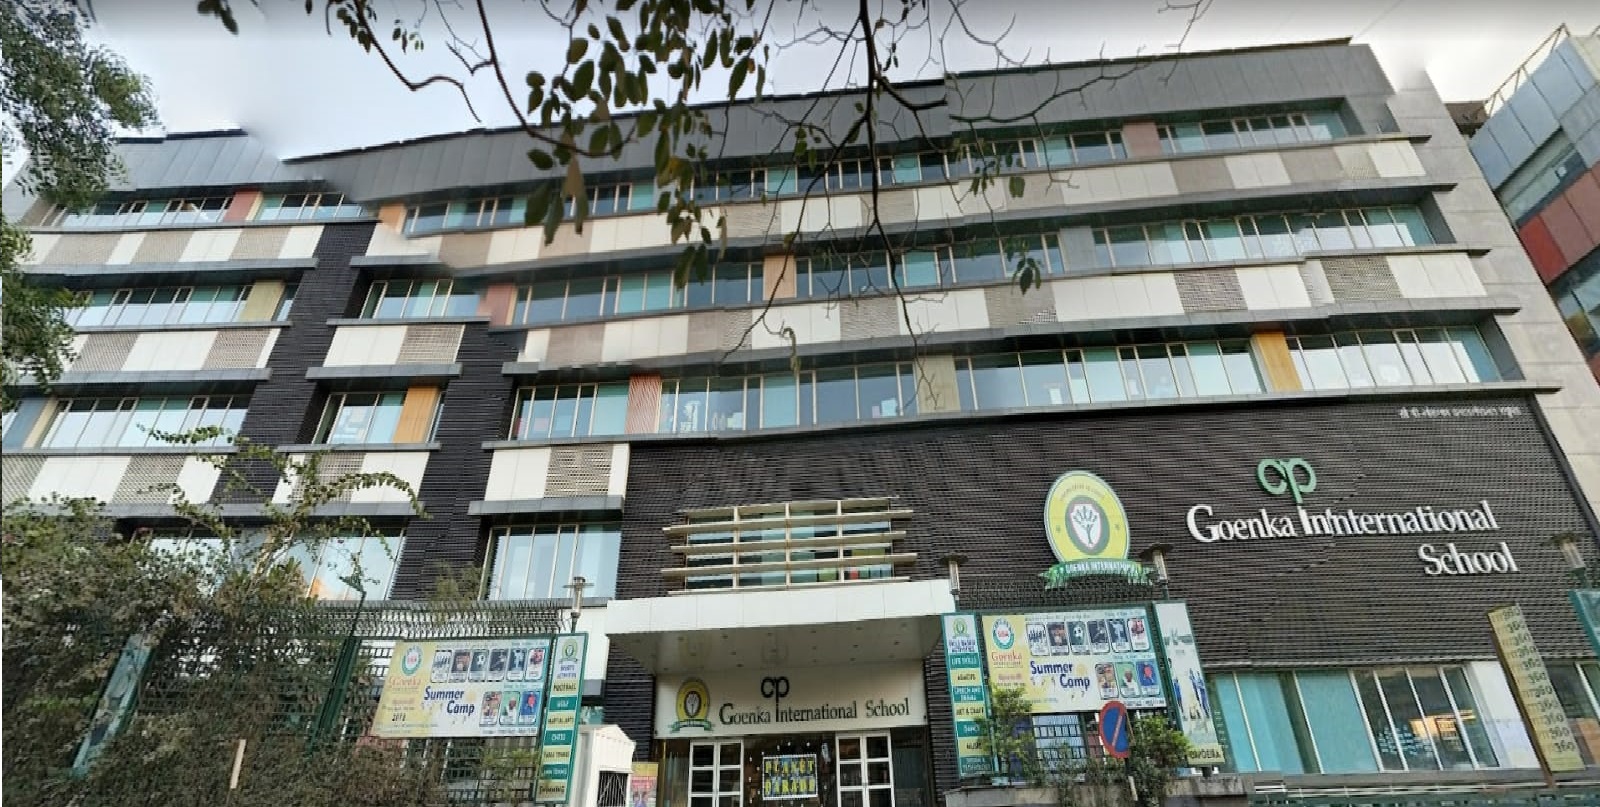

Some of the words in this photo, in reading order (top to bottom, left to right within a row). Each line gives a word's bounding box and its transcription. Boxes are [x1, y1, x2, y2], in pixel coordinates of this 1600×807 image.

[1186, 503, 1297, 542] Goenka
[1417, 541, 1520, 575] School
[1030, 660, 1073, 675] Summer
[1059, 673, 1090, 691] Camp
[424, 685, 465, 700] Summer
[446, 700, 475, 716] Camp
[719, 703, 771, 725] Goenka
[775, 700, 857, 722] International
[865, 697, 910, 717] School
[765, 759, 815, 774] PLANET
